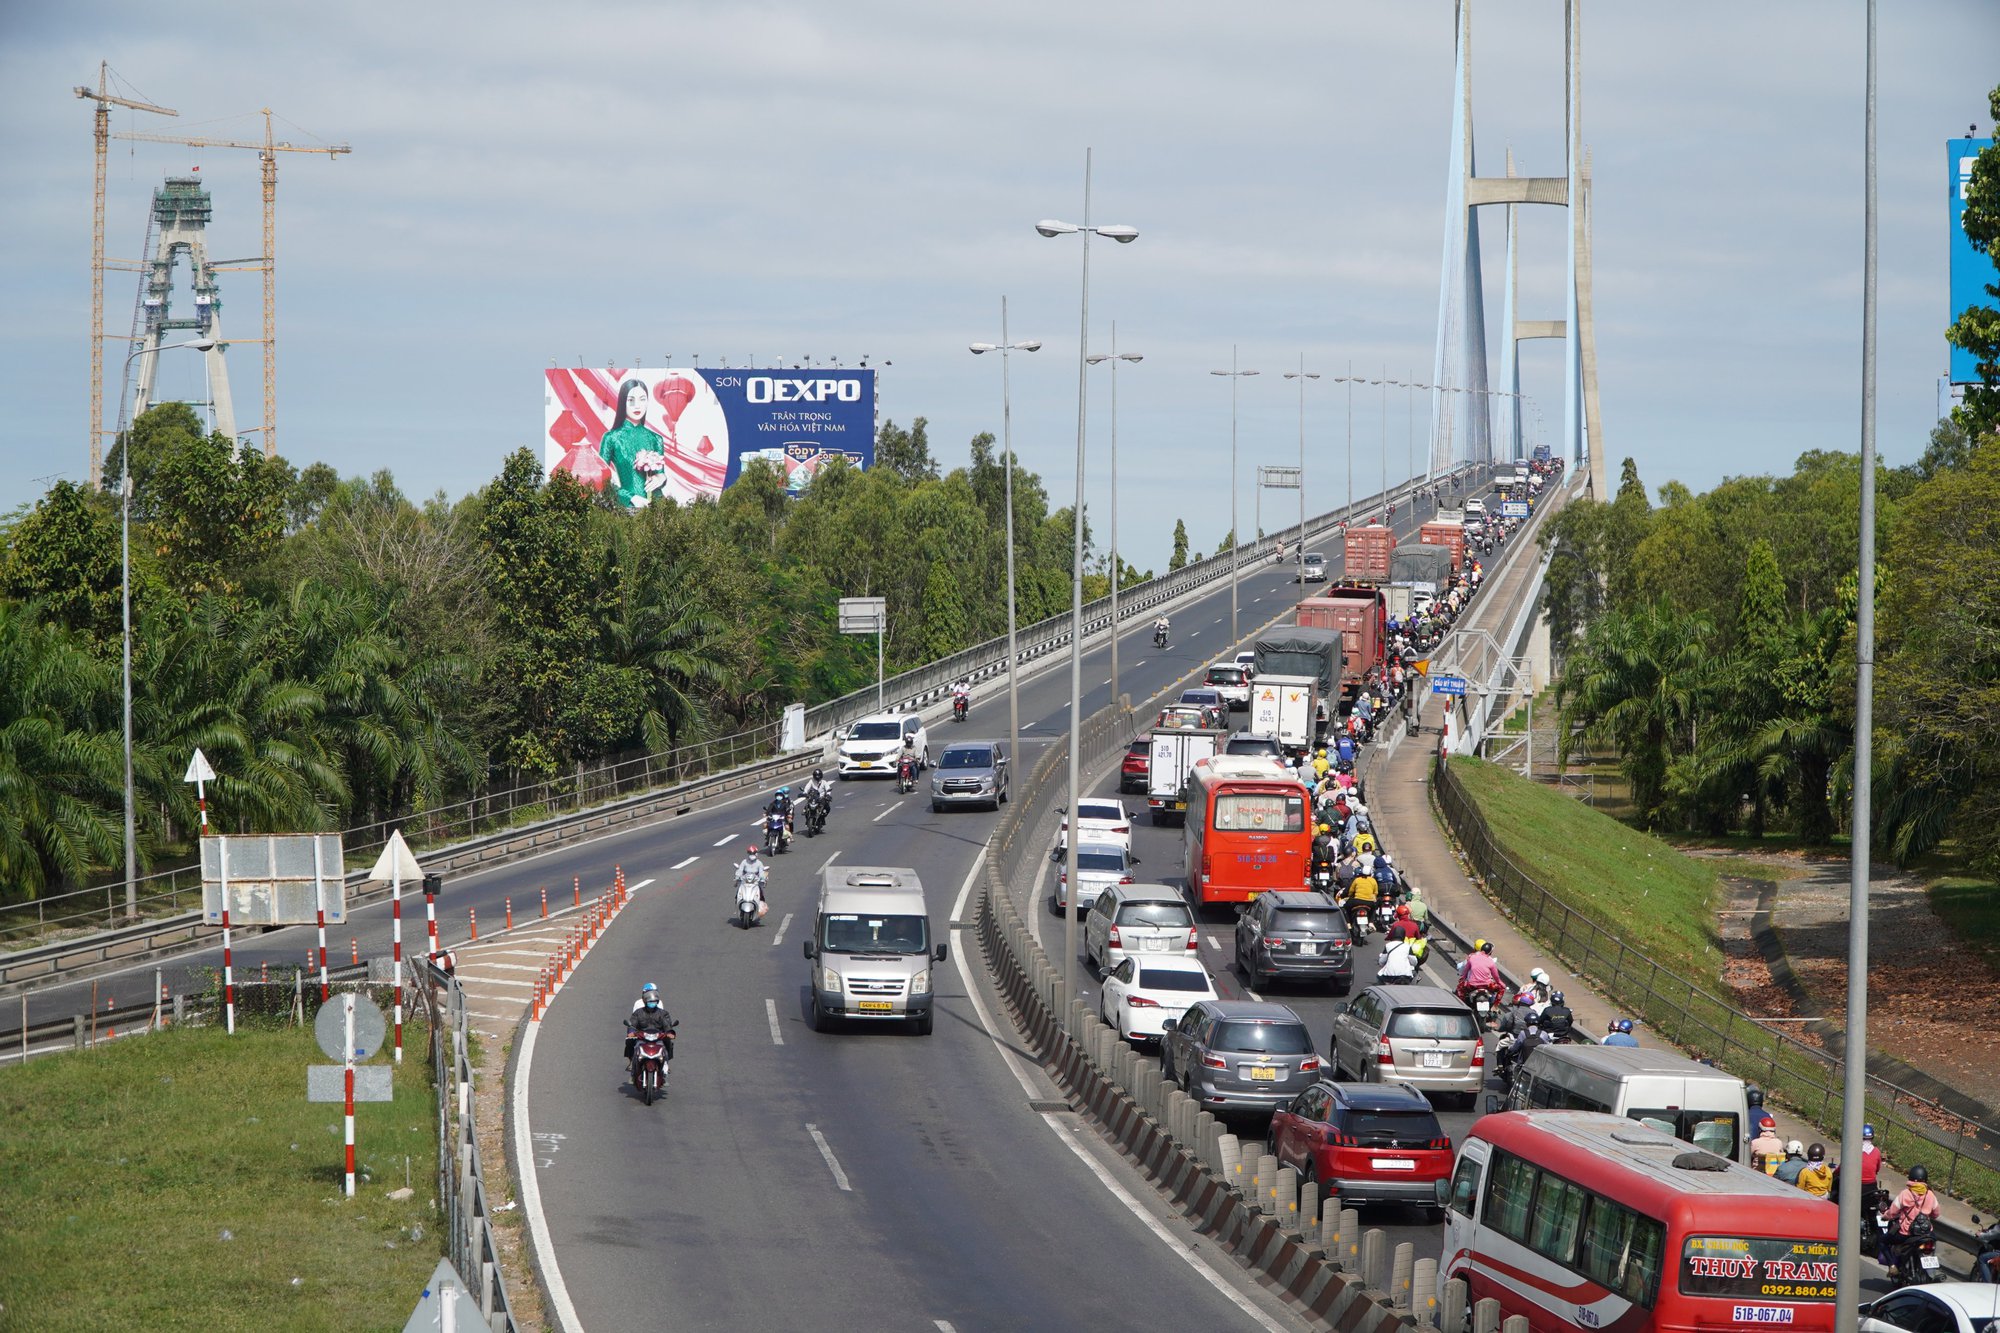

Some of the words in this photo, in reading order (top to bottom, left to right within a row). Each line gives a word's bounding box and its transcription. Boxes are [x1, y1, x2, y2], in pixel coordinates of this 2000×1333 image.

[715, 376, 742, 387] SƠN
[746, 377, 861, 404] OEXPO
[772, 411, 796, 421] TRÂN
[799, 412, 832, 423] TRỌNG
[779, 422, 800, 432] HÓA
[801, 423, 822, 434] VIỆT
[824, 424, 846, 432] NAM
[788, 447, 815, 456] CODY
[1691, 1239, 1705, 1249] BX.
[1792, 1244, 1806, 1254] BX.
[1761, 1284, 1837, 1297] 0392.880.45
[1735, 1307, 1792, 1322] 51B-067.04
